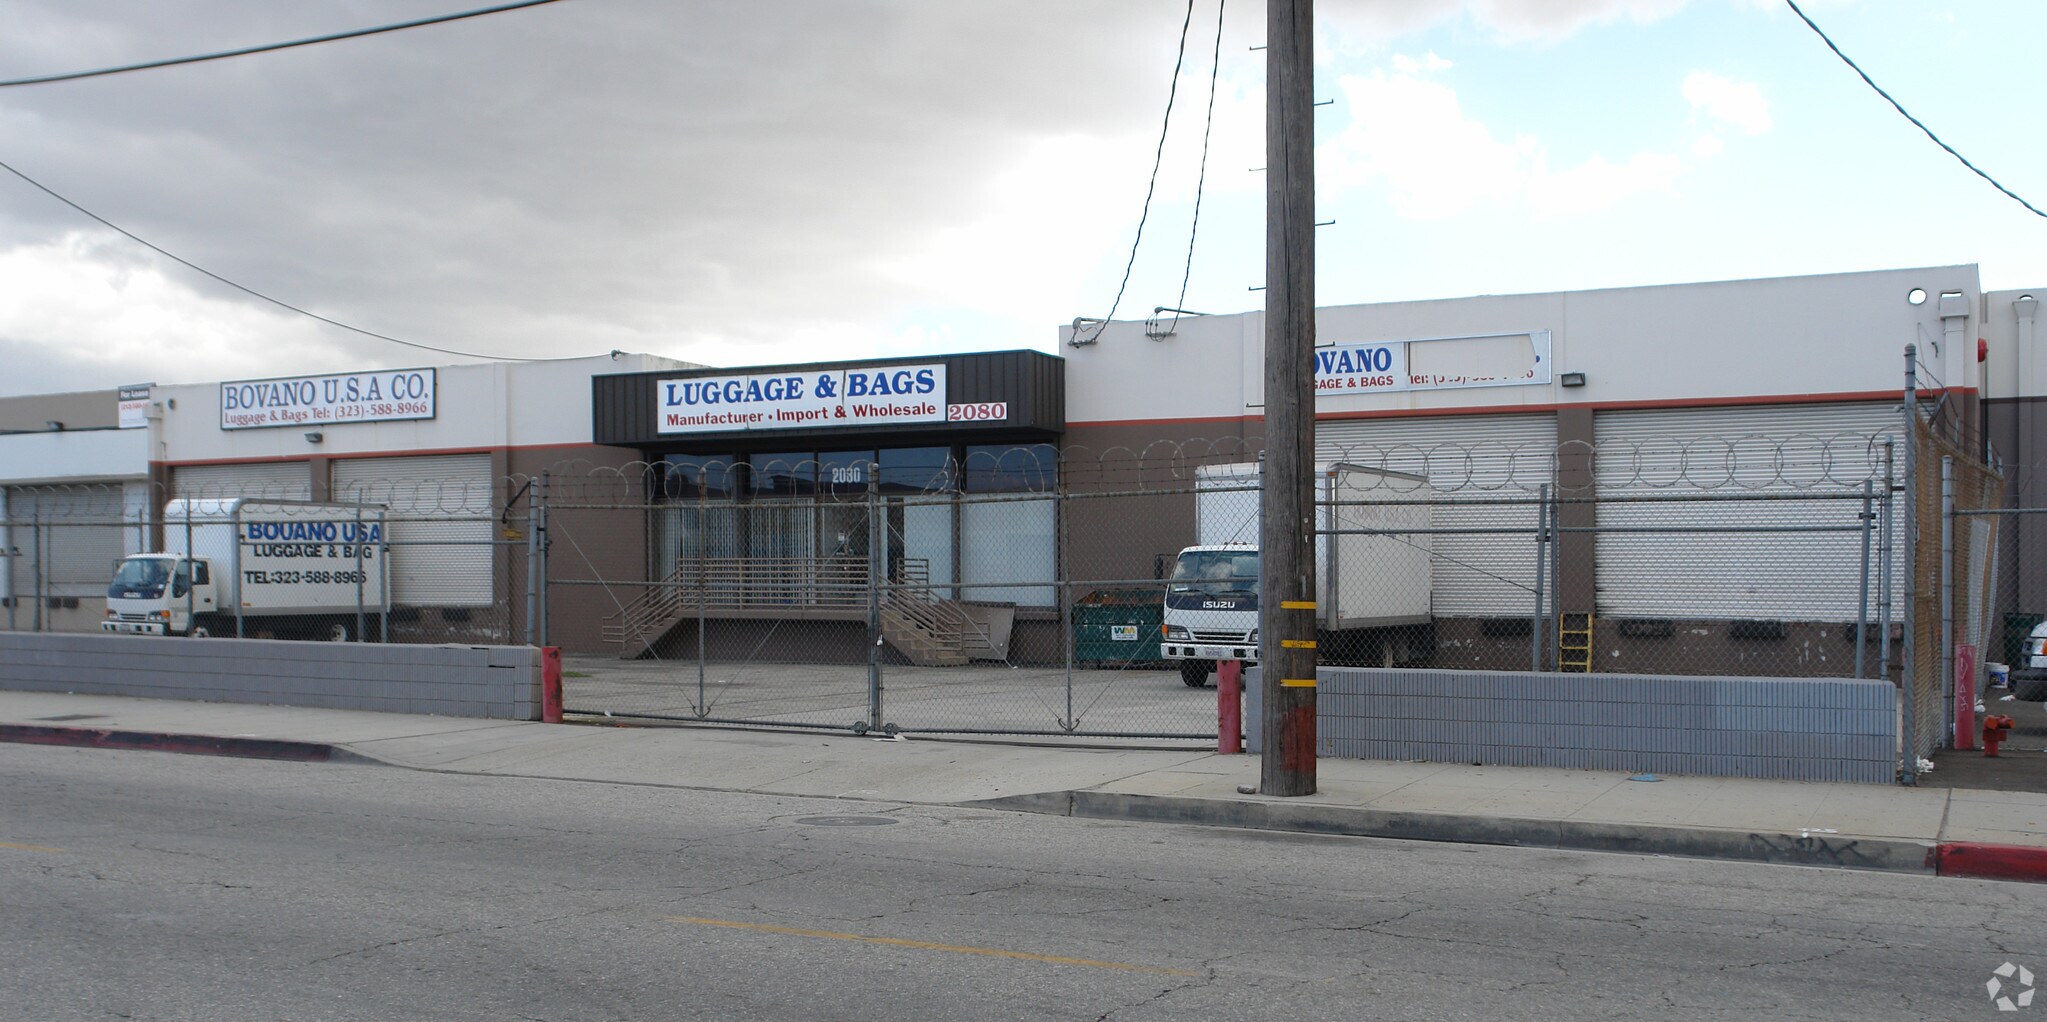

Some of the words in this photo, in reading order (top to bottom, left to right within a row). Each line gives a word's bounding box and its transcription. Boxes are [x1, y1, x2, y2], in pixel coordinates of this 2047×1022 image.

[225, 380, 315, 409] BOVANO
[323, 376, 382, 404] U.S.A
[391, 373, 428, 400] CO.
[666, 377, 804, 406] LUGGAGE
[814, 374, 837, 398] &
[847, 369, 935, 397] BAGS
[1347, 377, 1356, 388] &
[1361, 375, 1394, 387] BAGS
[225, 412, 266, 425] Luggage
[270, 410, 279, 421] &
[281, 408, 308, 422] Bags
[312, 407, 330, 419] Tel:
[335, 401, 427, 420] (323)-588-8966
[667, 411, 763, 426] Manufacturer
[777, 407, 828, 423] Import
[834, 405, 847, 419] &
[853, 402, 936, 417] Wholesale
[949, 403, 1005, 421] 2080
[342, 523, 380, 542] USA
[254, 544, 322, 558] LUGGAGE
[328, 545, 337, 558] &
[1203, 601, 1235, 609] ISUZU
